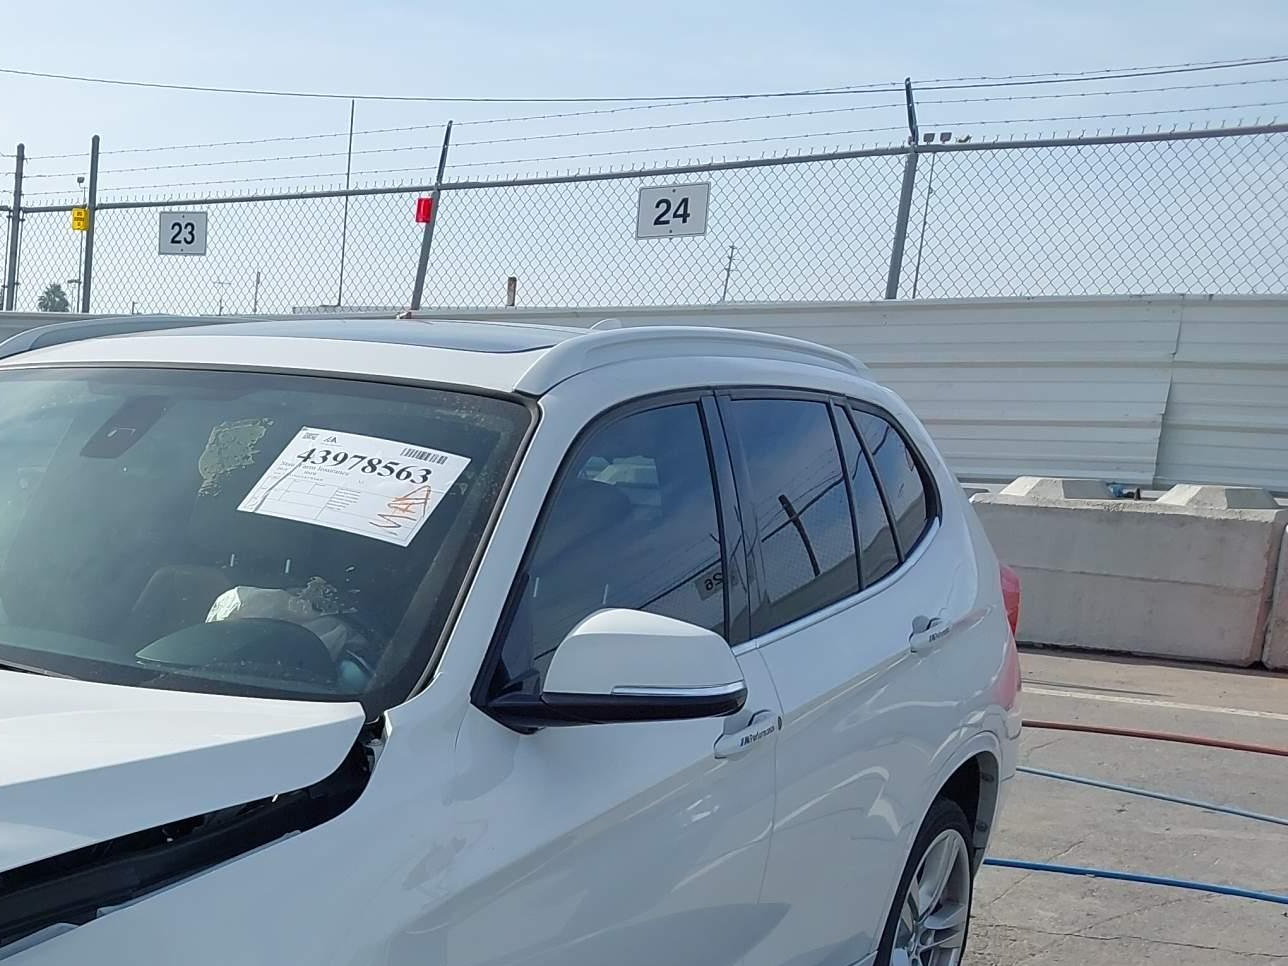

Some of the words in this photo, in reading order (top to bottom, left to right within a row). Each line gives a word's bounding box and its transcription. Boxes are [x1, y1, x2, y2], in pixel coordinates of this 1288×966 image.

[653, 197, 690, 226] 24
[170, 221, 196, 245] 23
[296, 447, 433, 485] 43978563
